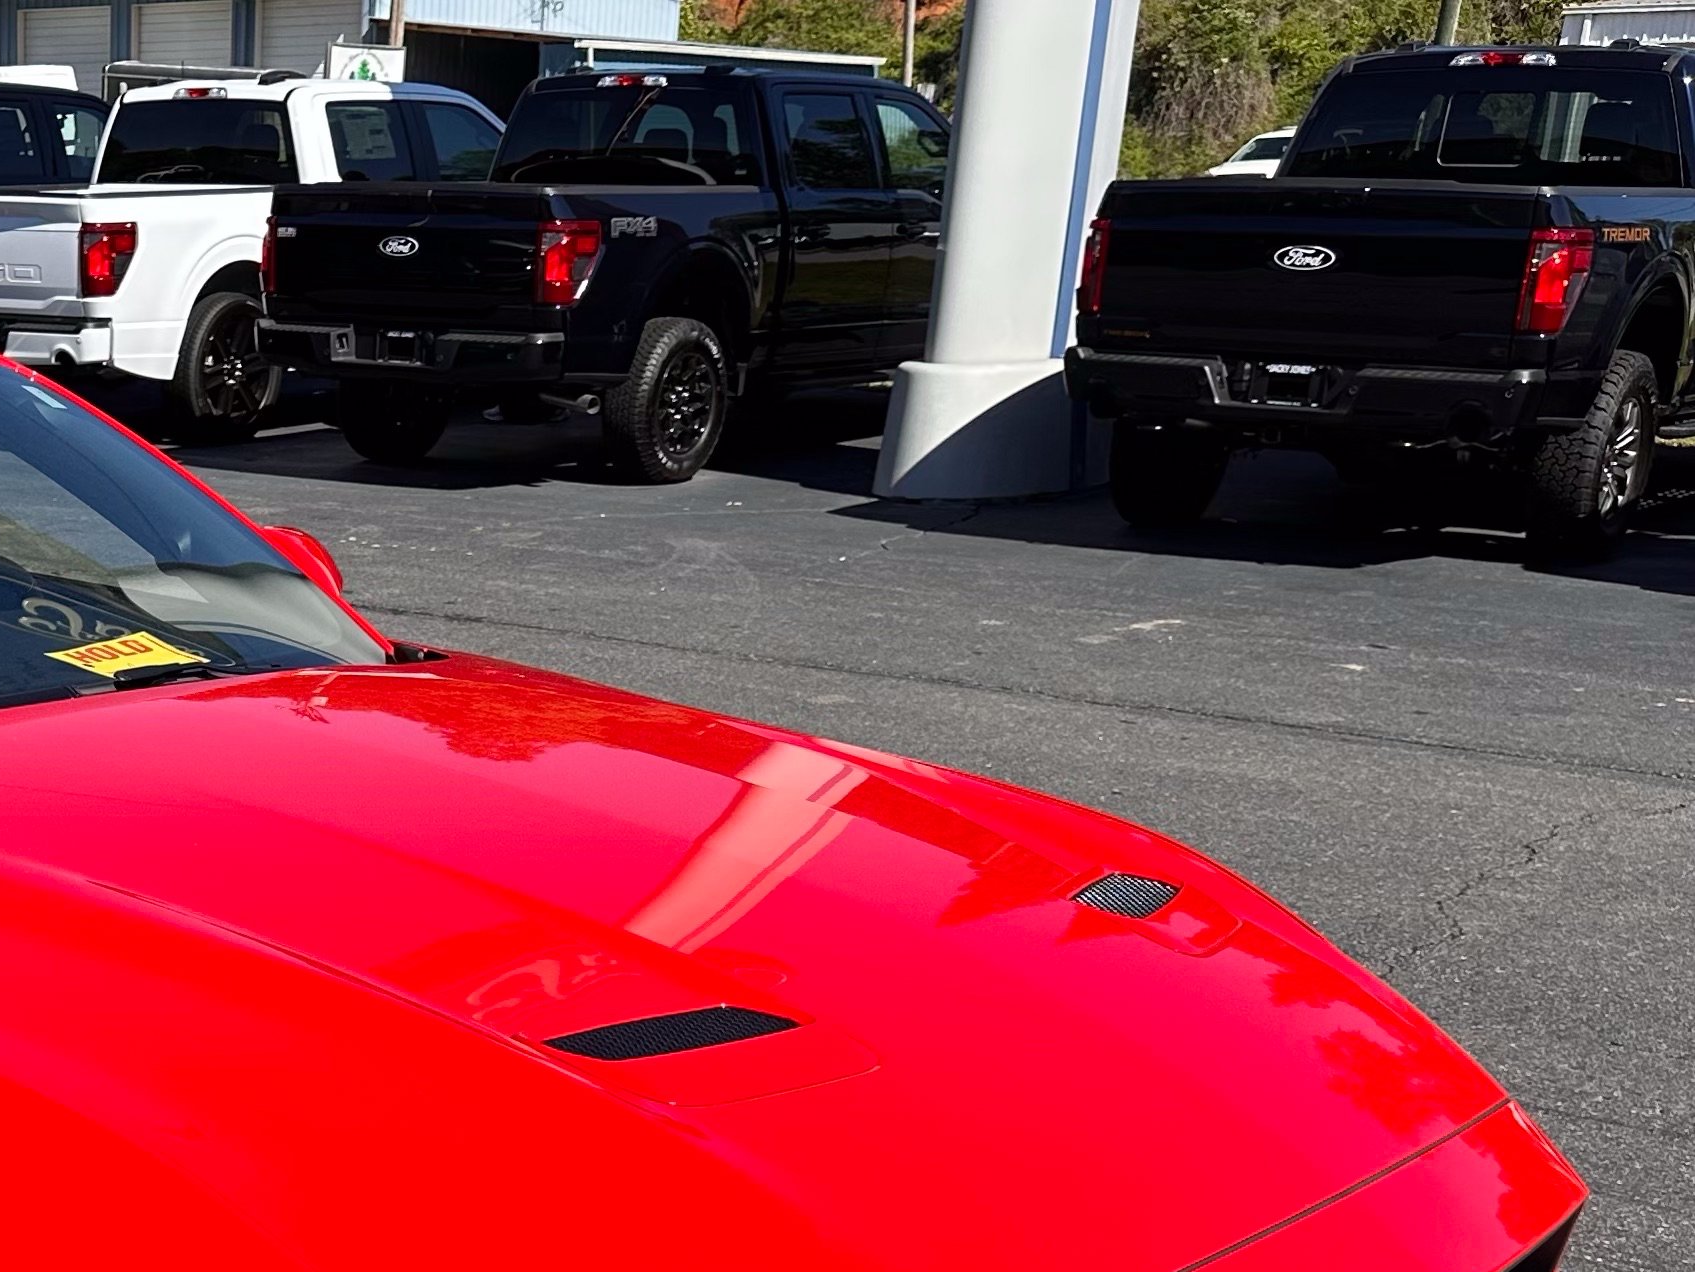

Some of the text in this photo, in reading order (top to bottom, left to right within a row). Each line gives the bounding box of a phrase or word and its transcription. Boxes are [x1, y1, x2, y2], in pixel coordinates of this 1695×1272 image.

[610, 216, 658, 238] FX4
[1602, 227, 1652, 241] TREMOR
[383, 238, 415, 254] Ford
[1280, 247, 1329, 268] Ford
[62, 639, 154, 664] HOLD
